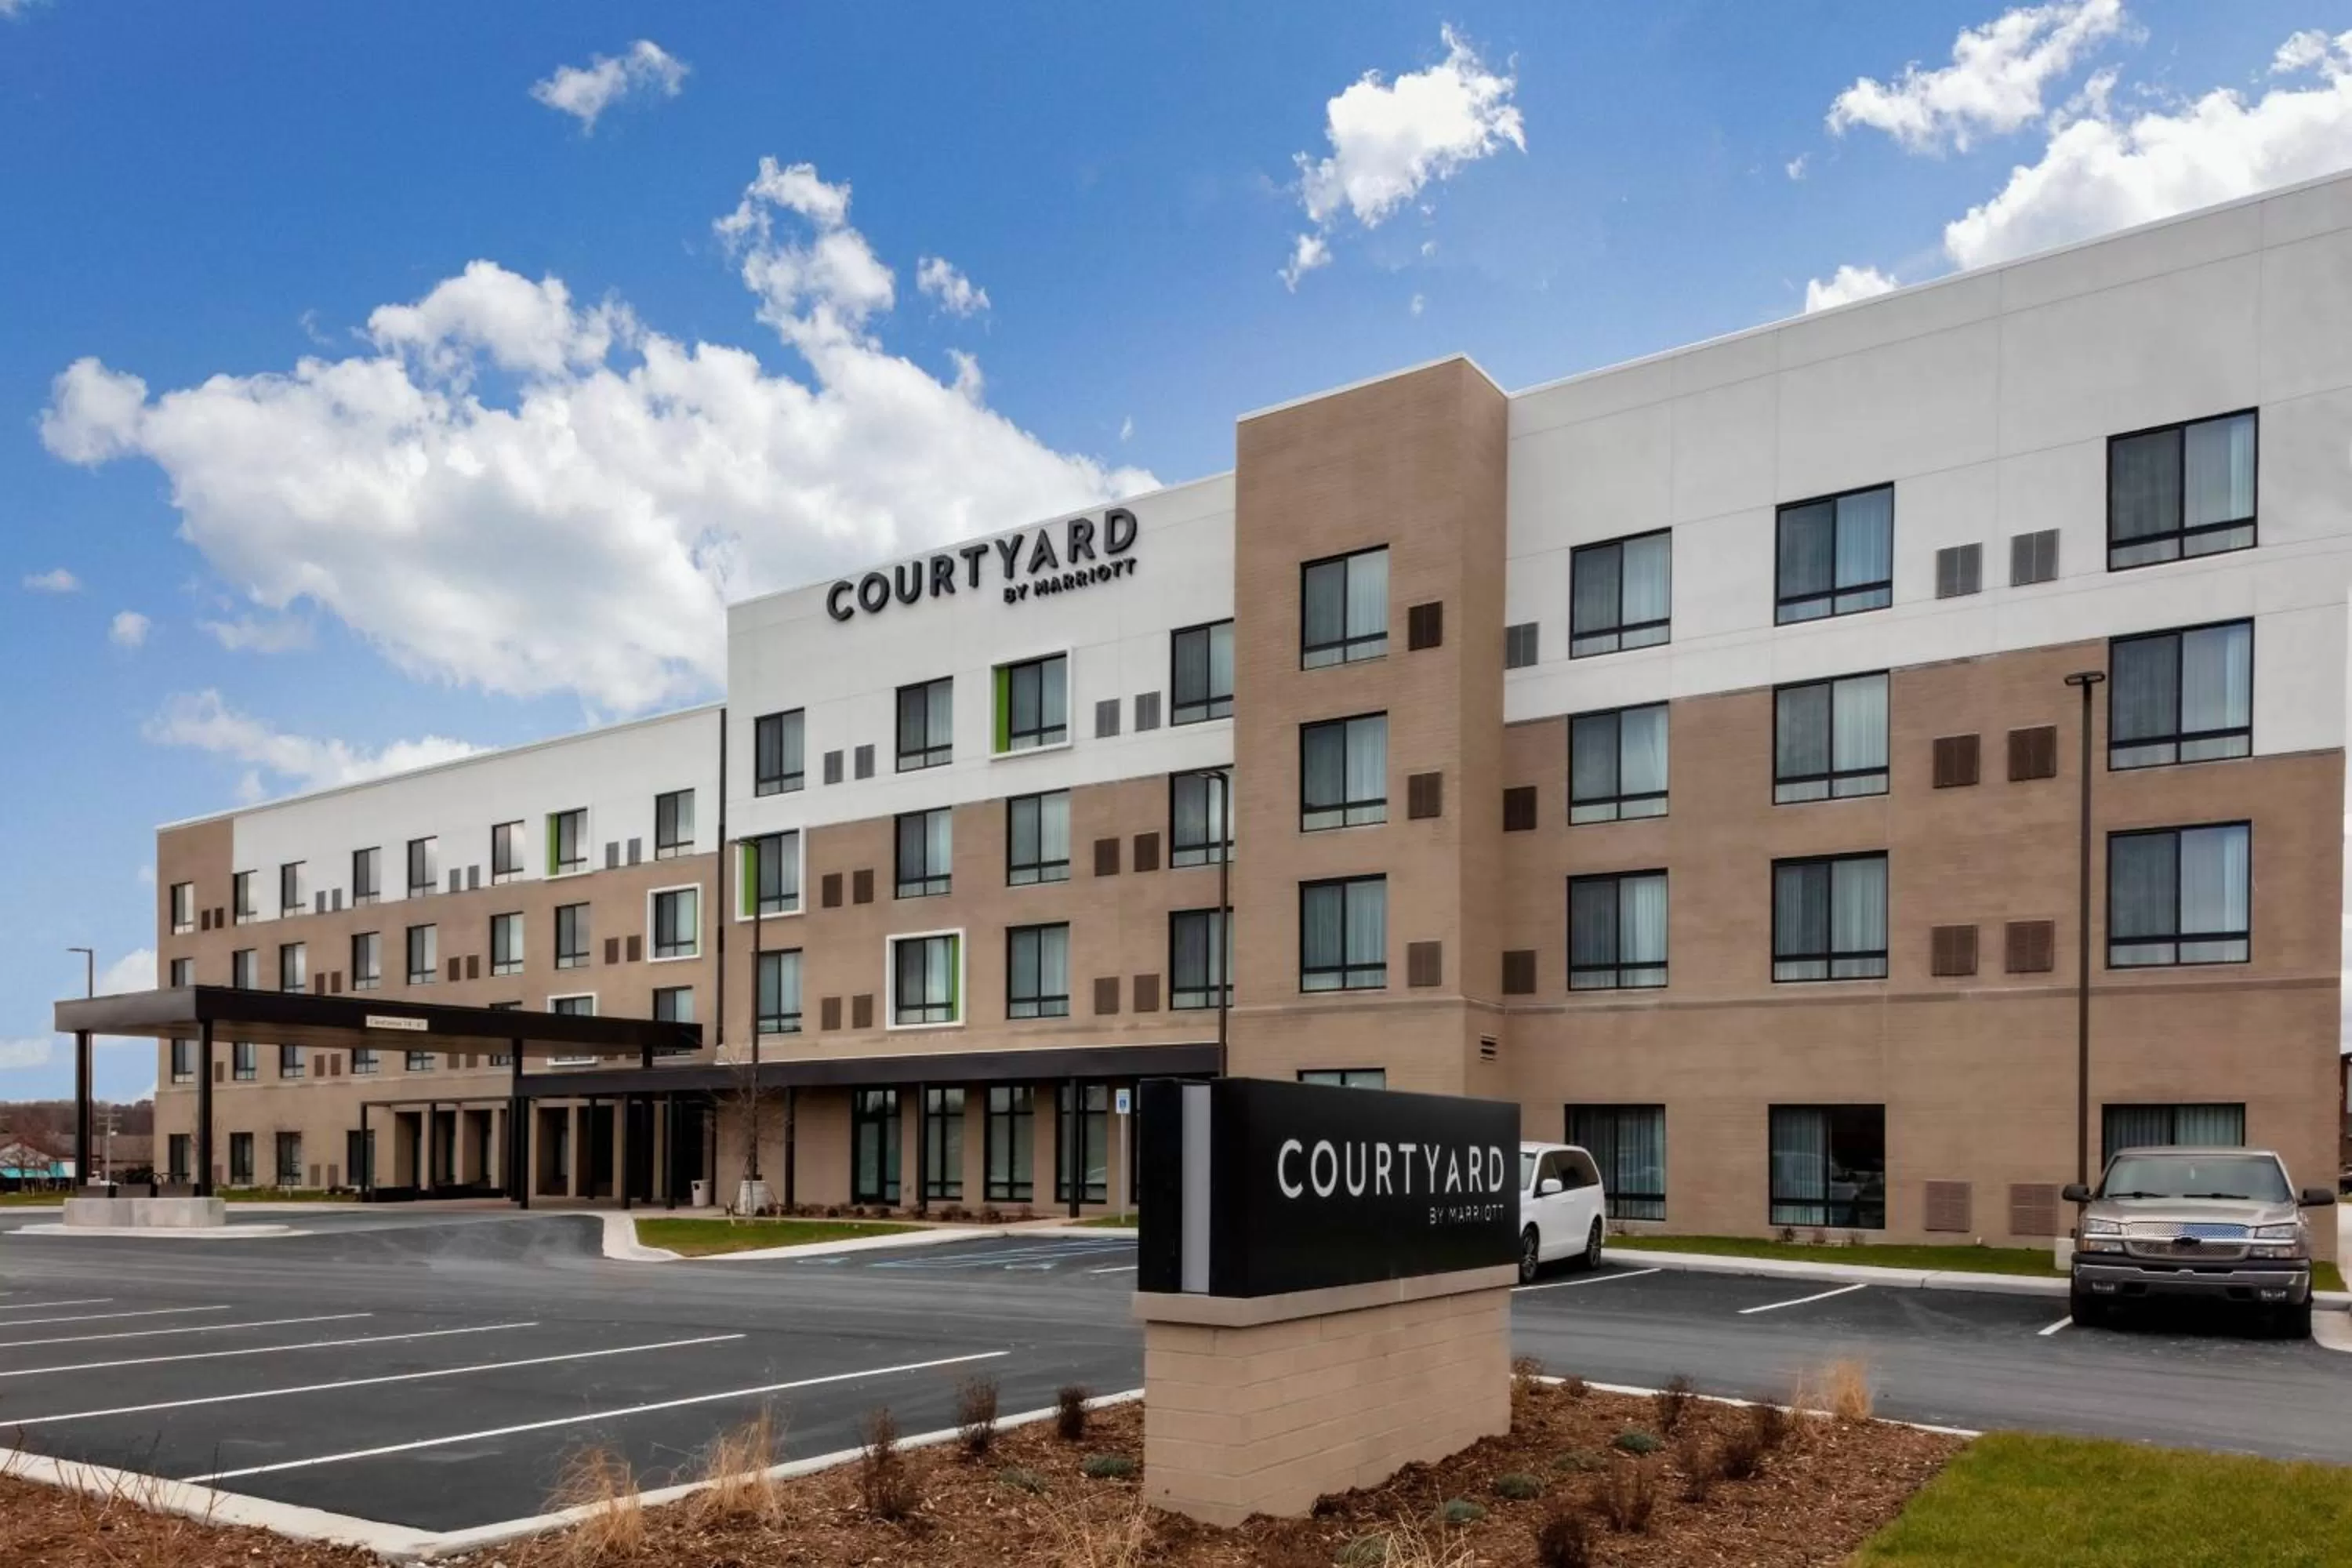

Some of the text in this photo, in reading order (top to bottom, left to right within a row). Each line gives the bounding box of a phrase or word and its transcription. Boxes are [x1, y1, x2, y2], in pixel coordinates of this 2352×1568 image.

[826, 507, 1138, 622] COURTYARD
[1003, 557, 1138, 604] BY MARRIOTT
[1277, 1138, 1504, 1199] COURTYARD
[1429, 1204, 1505, 1225] BY MARRIOTT
